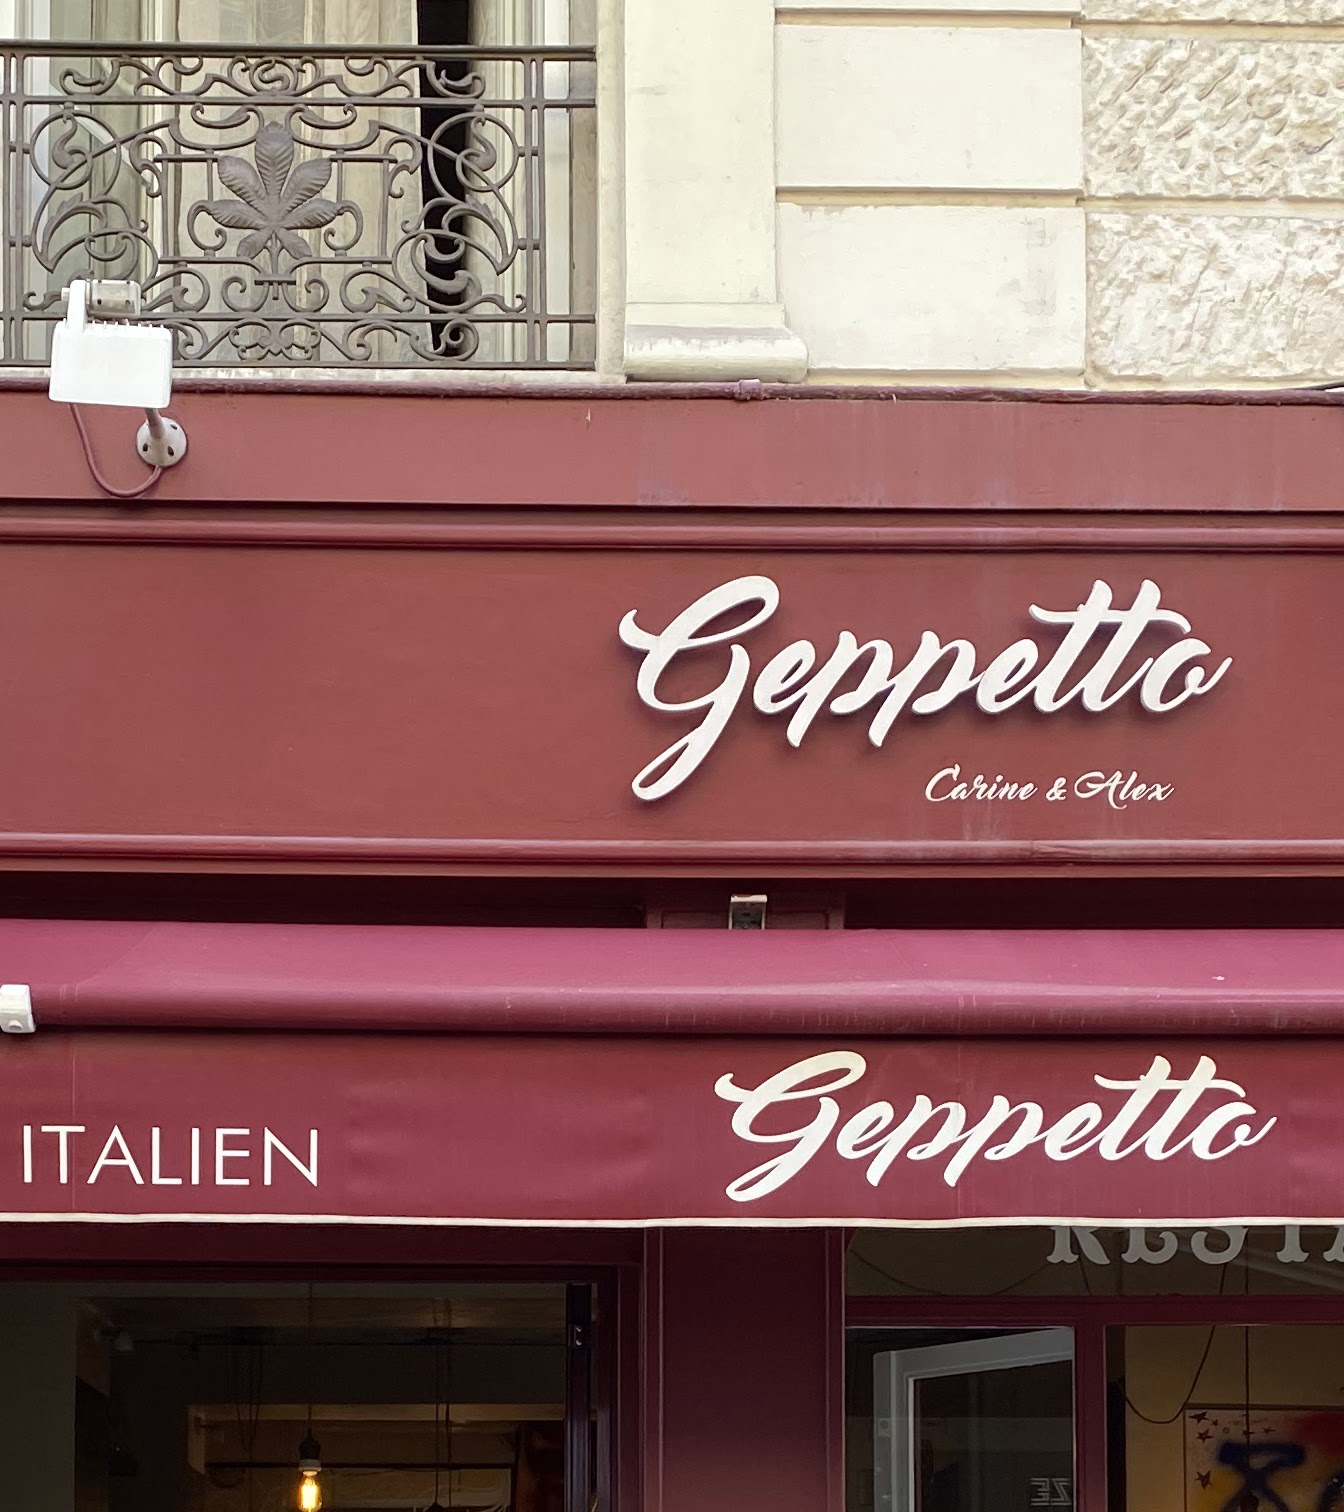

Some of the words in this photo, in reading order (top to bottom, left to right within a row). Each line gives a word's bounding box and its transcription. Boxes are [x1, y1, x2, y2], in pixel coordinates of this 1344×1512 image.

[618, 575, 1232, 800] Geppetto
[924, 763, 1039, 803] Carine
[1046, 774, 1068, 800] &
[1073, 771, 1174, 810] Alex
[22, 1124, 320, 1187] ITALIEN
[714, 1050, 1278, 1202] Geppetto
